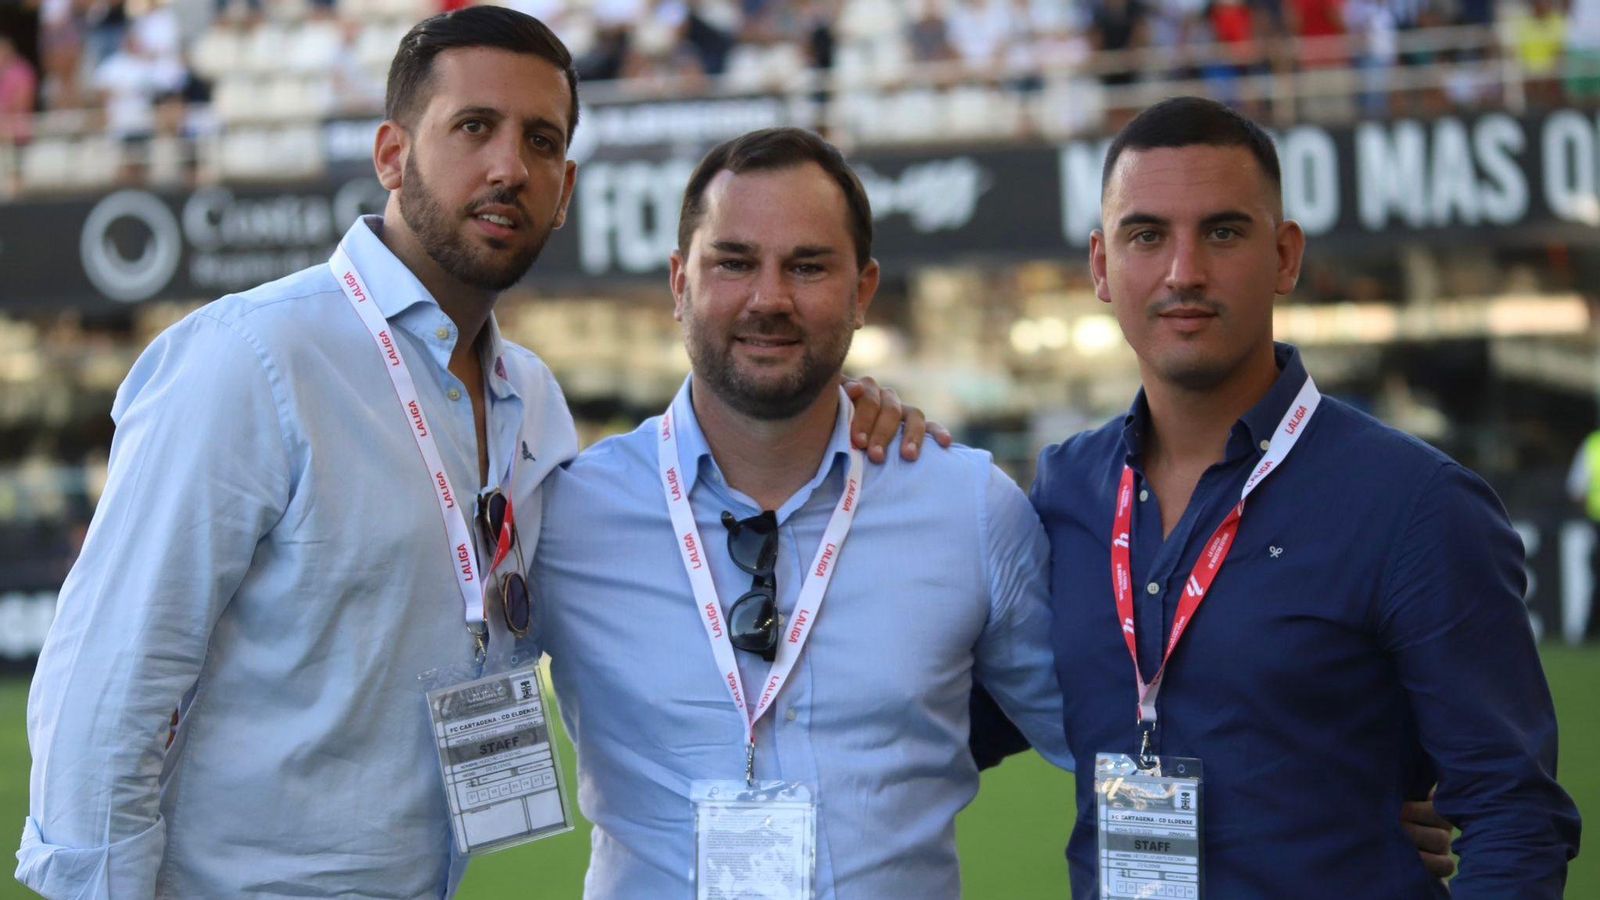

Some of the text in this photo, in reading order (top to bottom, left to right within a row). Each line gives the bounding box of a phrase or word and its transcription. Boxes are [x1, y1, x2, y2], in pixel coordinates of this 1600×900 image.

[1355, 112, 1529, 232] MAS
[343, 271, 367, 303] LALIGA
[379, 330, 400, 366] LALIGA
[407, 400, 428, 437] LALIGA
[1284, 404, 1308, 435] LALIGA
[435, 471, 454, 509] LALIGA
[666, 467, 682, 501] LALIGA
[843, 479, 857, 512] LALIGA
[456, 543, 474, 581] LALIGA
[683, 532, 702, 569] LALIGA
[815, 542, 836, 577] LALIGA
[705, 602, 723, 638] LALIGA
[788, 609, 810, 643] LALIGA
[727, 671, 744, 708] LALIGA
[758, 675, 780, 709] LALIGA
[459, 717, 497, 731] CARTAGENA
[511, 706, 539, 718] ELDENSE
[479, 735, 519, 755] STAFF
[1134, 839, 1171, 852] STAFF
